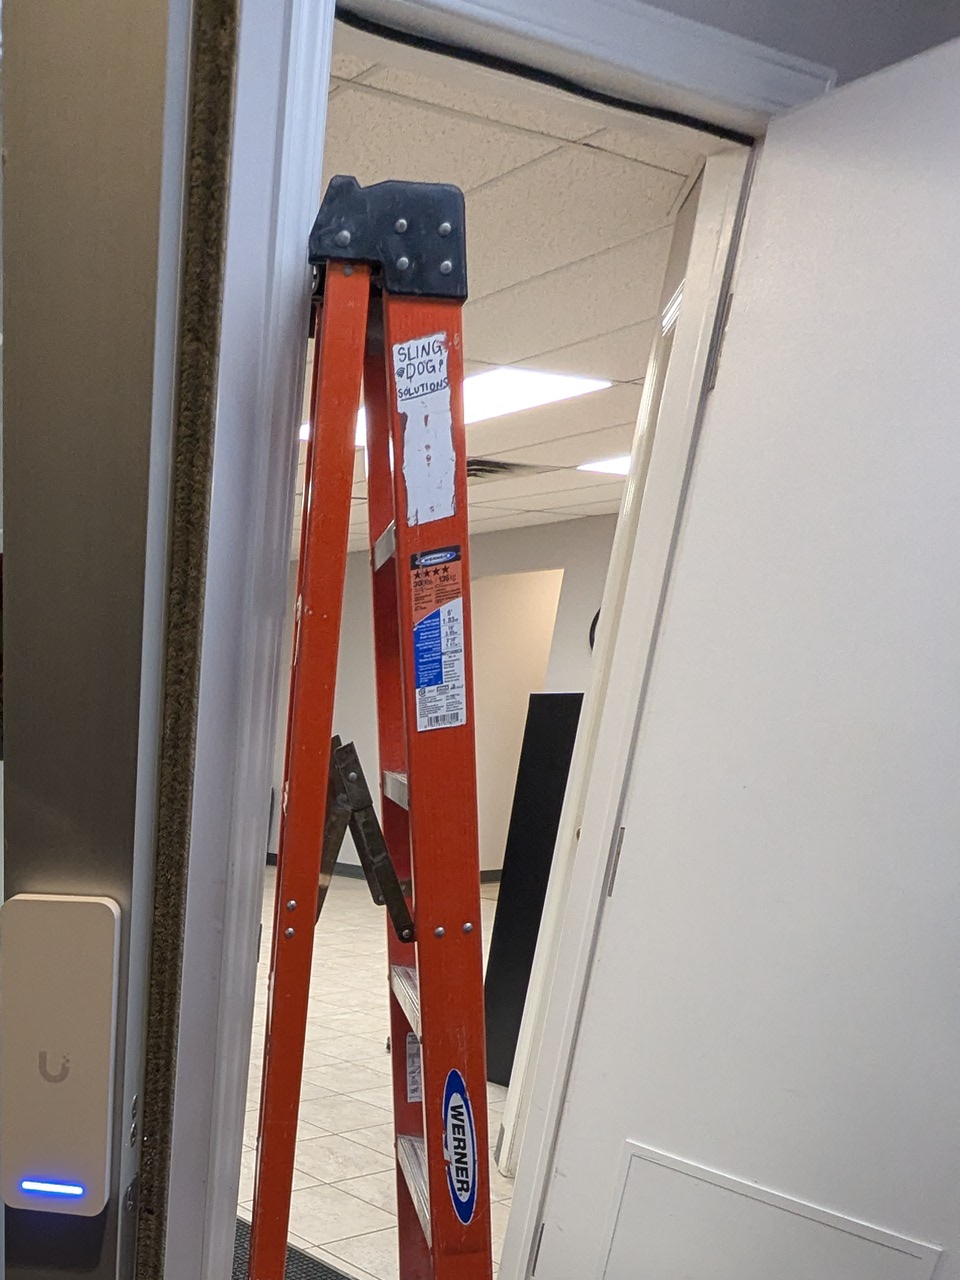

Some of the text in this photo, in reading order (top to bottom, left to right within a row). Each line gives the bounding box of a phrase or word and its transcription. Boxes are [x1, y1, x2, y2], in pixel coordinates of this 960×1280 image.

[397, 340, 443, 362] SLING
[398, 377, 449, 399] SOLUTIONS
[450, 1104, 470, 1197] WERNER
